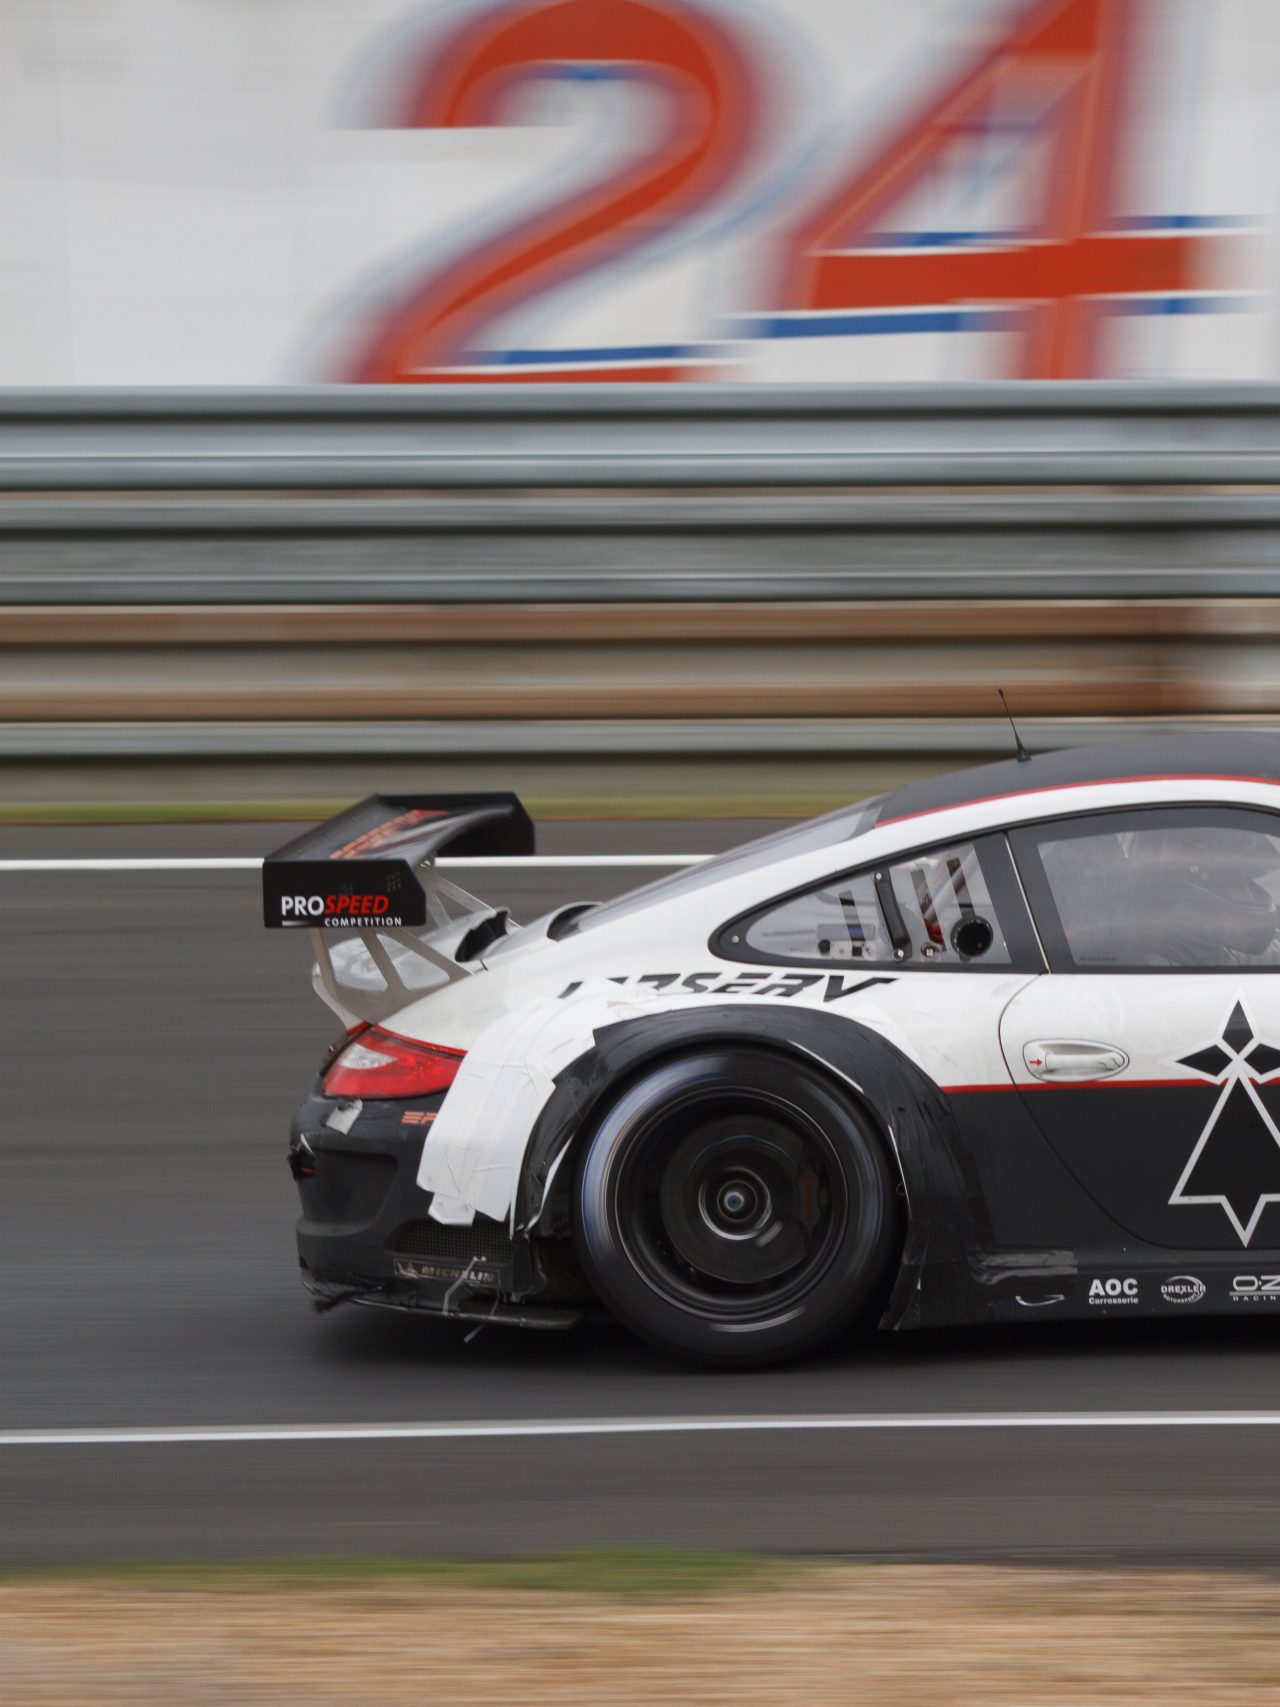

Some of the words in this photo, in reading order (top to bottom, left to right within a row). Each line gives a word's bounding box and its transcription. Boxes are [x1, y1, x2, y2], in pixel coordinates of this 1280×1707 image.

[350, 0, 1245, 382] 24
[281, 895, 389, 916] PROSPEED
[324, 916, 402, 928] COMPETITION
[1089, 1278, 1139, 1296] AOC
[1161, 1284, 1206, 1293] DREXLER
[1088, 1296, 1139, 1305] Carrosserie
